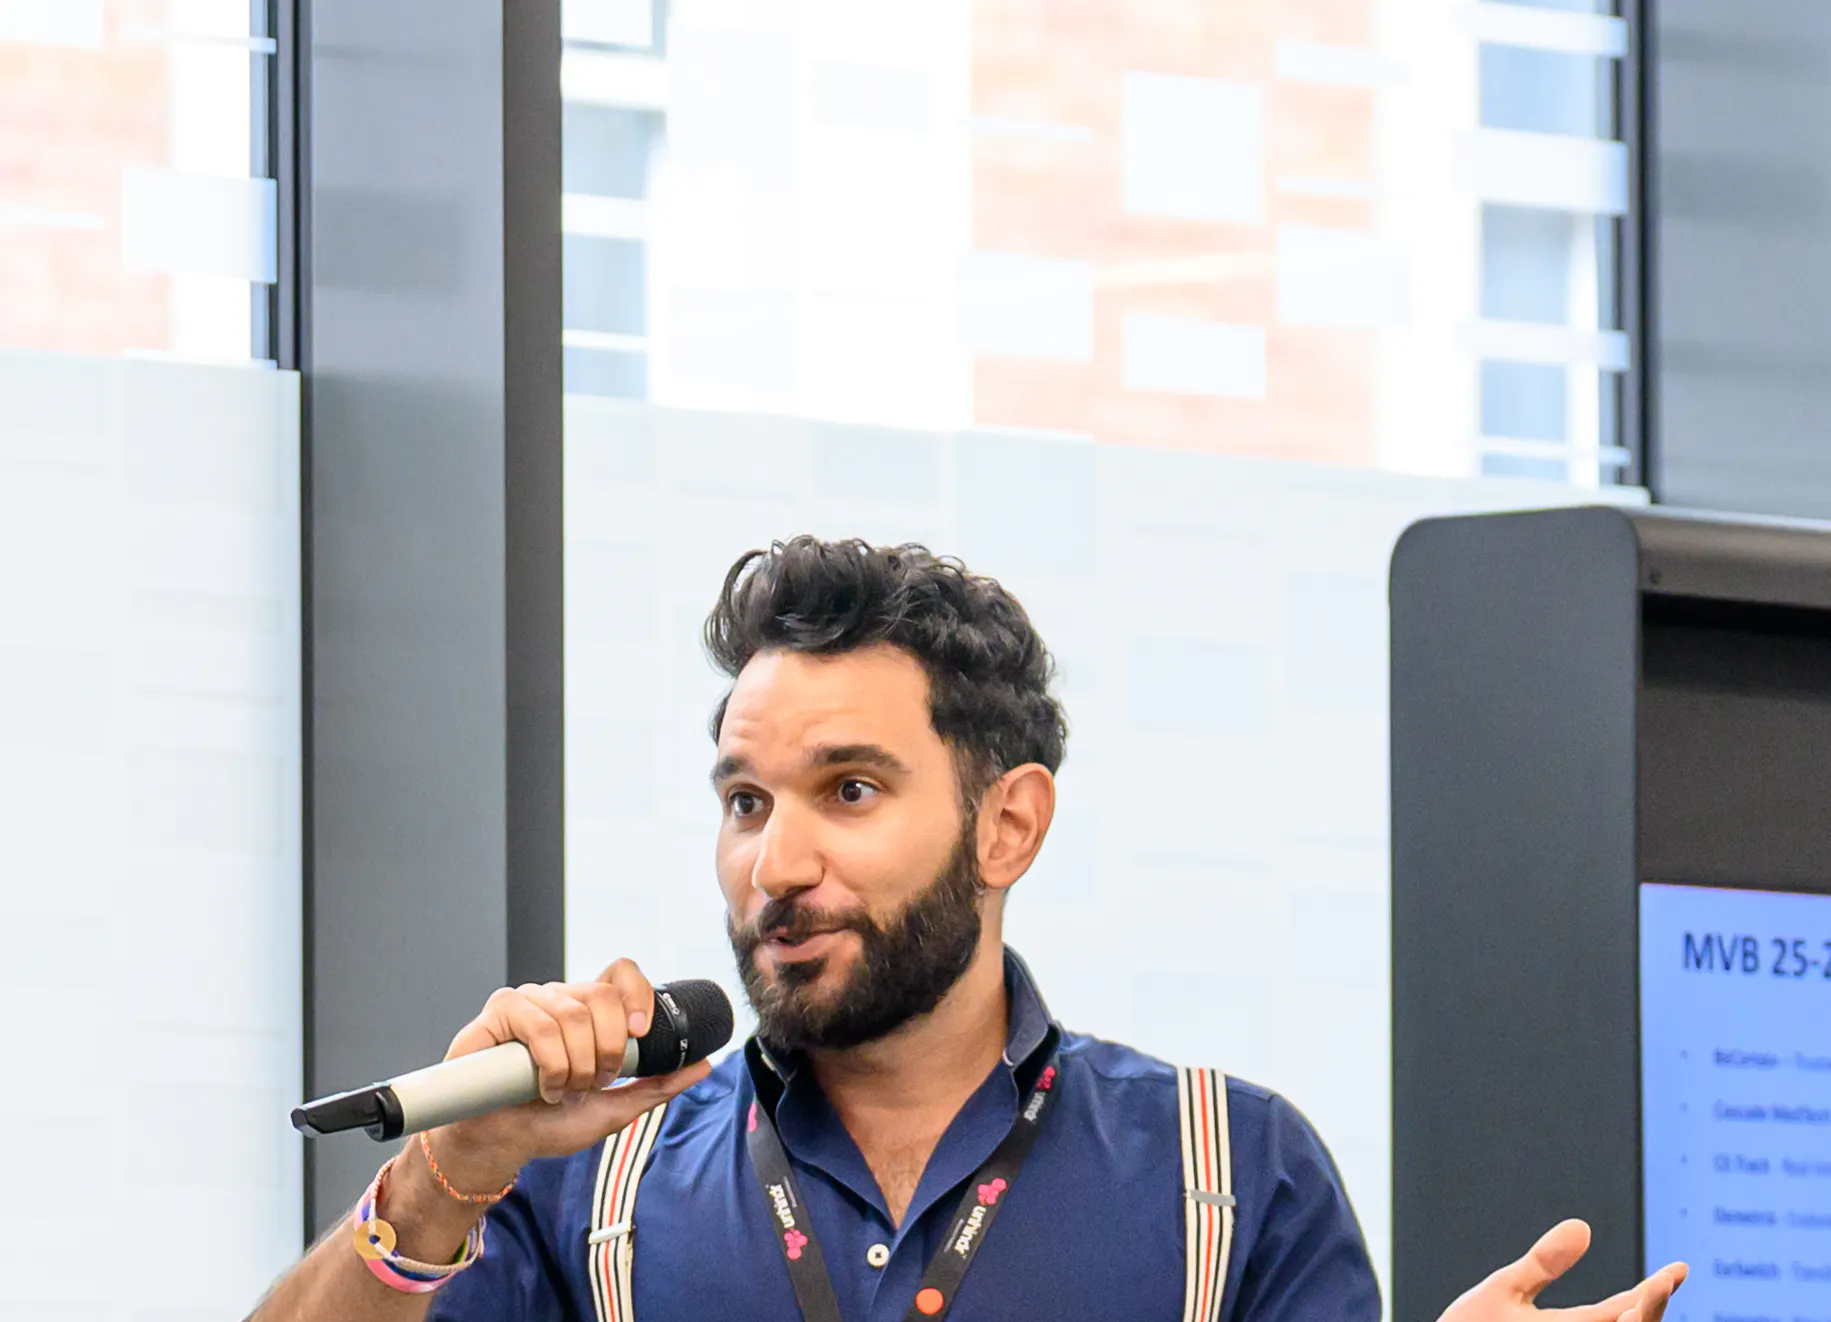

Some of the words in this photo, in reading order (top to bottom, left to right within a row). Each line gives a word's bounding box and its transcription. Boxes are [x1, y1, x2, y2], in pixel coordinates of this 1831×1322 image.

[1683, 932, 1760, 973] MVB
[769, 1184, 795, 1228] unhindr
[954, 1205, 986, 1255] unhindr
